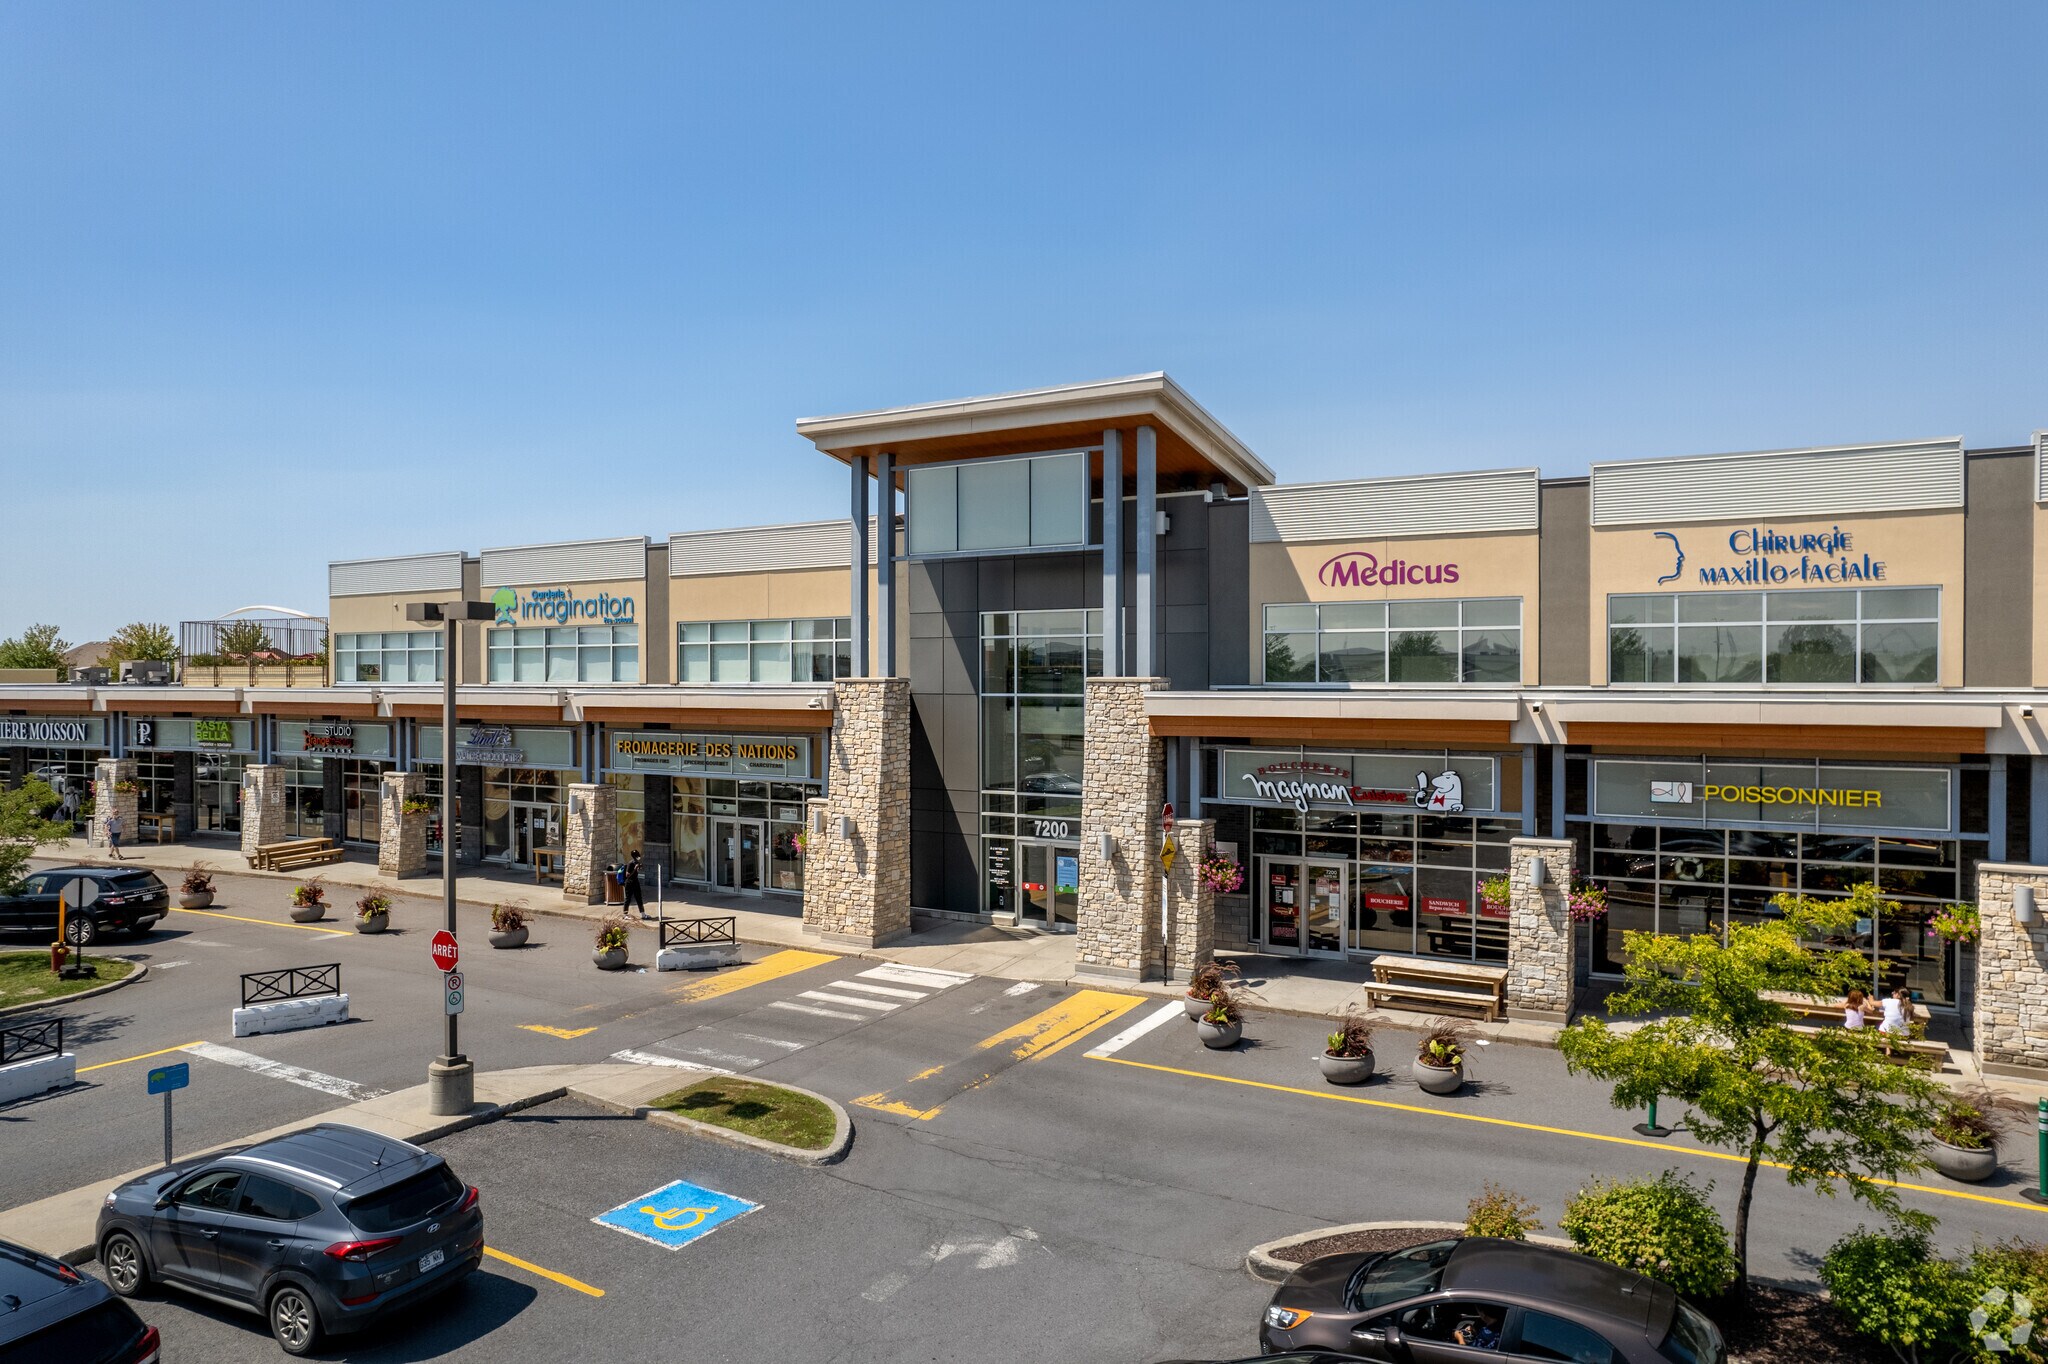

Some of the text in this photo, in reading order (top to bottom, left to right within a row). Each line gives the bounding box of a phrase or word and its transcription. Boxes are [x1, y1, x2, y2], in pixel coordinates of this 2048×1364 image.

[1319, 551, 1460, 587] Medicus
[531, 589, 565, 600] Garderie
[521, 592, 635, 623] imagination
[29, 722, 87, 741] MOISSON
[195, 720, 229, 731] PASTA
[325, 726, 352, 736] STUDIO
[195, 731, 229, 742] BELLA
[466, 727, 500, 746] Lindt
[617, 740, 797, 760] FROMAGERIE DES NATIONS
[1257, 761, 1350, 779] BOUCHERIE
[1350, 786, 1408, 802] Cuisine
[1704, 784, 1883, 808] POISSONNIER
[1034, 820, 1069, 838] 7200
[1370, 897, 1404, 906] BOUCHERIE
[432, 943, 458, 958] ARRÊT
